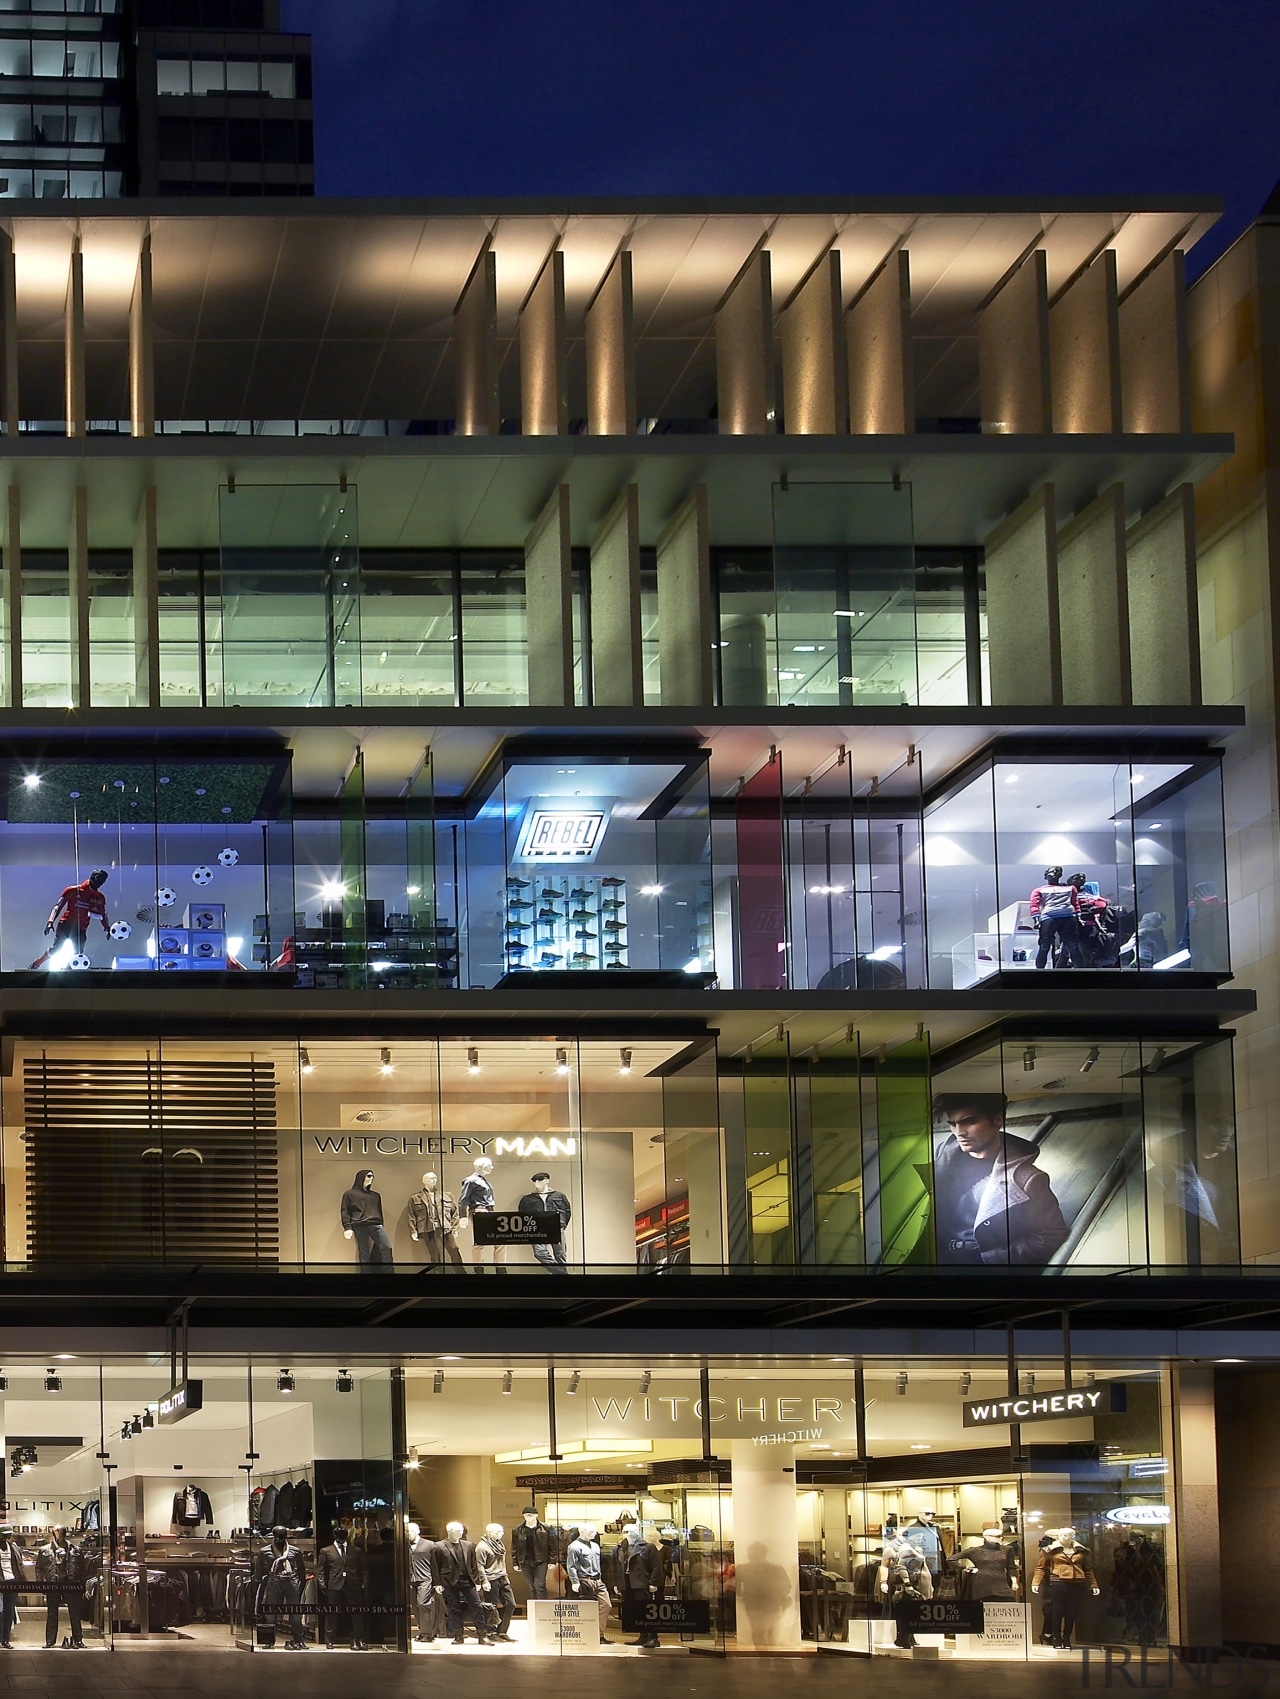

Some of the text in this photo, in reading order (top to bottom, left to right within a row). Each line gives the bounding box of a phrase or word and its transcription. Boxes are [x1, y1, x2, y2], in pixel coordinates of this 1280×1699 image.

[537, 820, 594, 844] REBEL
[496, 1215, 537, 1233] 30%
[523, 1225, 538, 1233] OFF
[592, 1397, 877, 1421] WITCHERY
[971, 1391, 1101, 1420] WITCHERY
[645, 1603, 686, 1620] 30%
[920, 1604, 960, 1621] 30%
